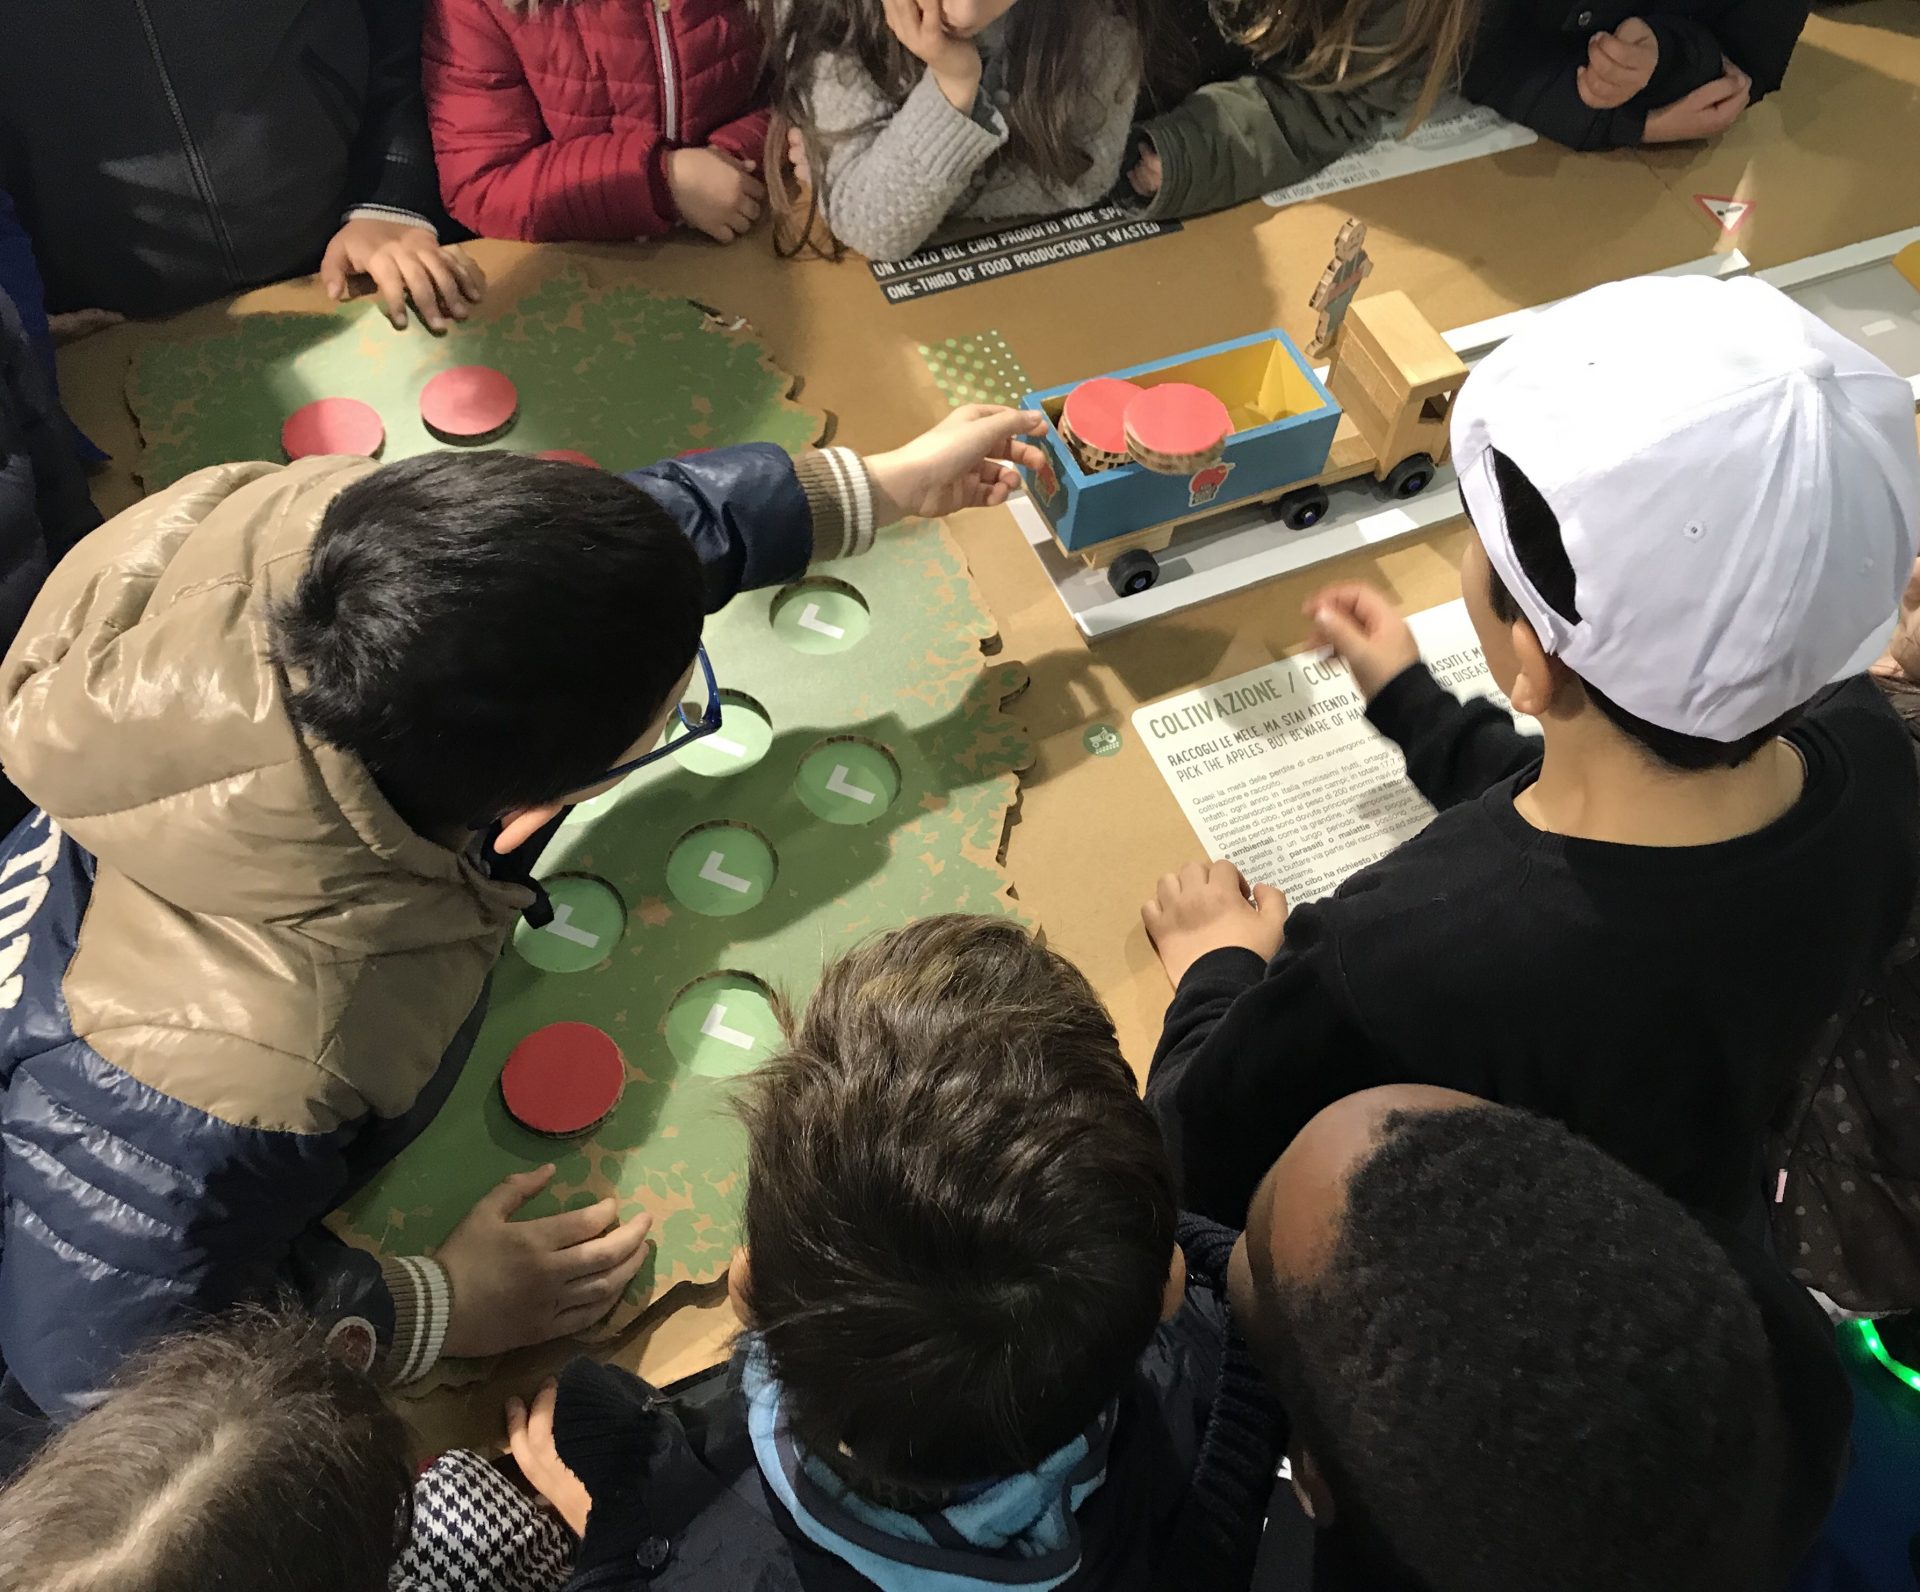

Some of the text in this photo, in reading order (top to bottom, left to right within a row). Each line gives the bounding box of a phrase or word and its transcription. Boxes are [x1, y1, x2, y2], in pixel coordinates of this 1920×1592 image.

[873, 263, 896, 276] UN
[899, 252, 940, 271] TERZO
[942, 245, 966, 260] DEL
[967, 238, 997, 253] CIBO
[999, 222, 1060, 245] PRODOTTO
[1061, 211, 1098, 229] VIENE
[888, 223, 1160, 298] ONE-THIRD OF FOOD PRODUCTION IS WASTED
[1150, 680, 1280, 738] COLTIVAZIONE
[1288, 672, 1294, 693] /
[1168, 741, 1219, 766] RACCOGLI
[1219, 736, 1233, 748] LE
[1263, 719, 1281, 733] MA
[1281, 710, 1306, 726] STAI
[1308, 695, 1349, 717] ATTENTO
[1351, 692, 1360, 702] A
[1462, 651, 1472, 662] E
[1177, 765, 1203, 782] PICK
[1203, 757, 1224, 772] THE
[1267, 733, 1287, 749] BUT
[1289, 719, 1330, 741] BEWARE
[1331, 713, 1344, 726] OF
[1192, 794, 1215, 805] Quasi
[1249, 775, 1267, 785] delle
[1269, 765, 1295, 778] perdite
[1307, 754, 1324, 764] cibo
[1326, 739, 1365, 757] avvengono
[1199, 795, 1242, 814] coltivazione
[1209, 821, 1228, 832] sono
[1229, 803, 1276, 824] abbandonati
[1283, 791, 1311, 804] marcire
[1312, 785, 1323, 794] nei
[1358, 766, 1379, 776] totale
[1213, 824, 1251, 841] tonnellate
[1252, 819, 1260, 827] di
[1281, 807, 1295, 818] pari
[1297, 803, 1304, 811] al
[1305, 797, 1324, 809] peso
[1325, 792, 1332, 800] di
[1332, 787, 1348, 797] 200
[1349, 777, 1374, 791] enormi
[1375, 771, 1391, 781] navi
[1230, 803, 1247, 813] ogni
[1250, 796, 1269, 806] anno
[1281, 784, 1300, 794] Italia
[1302, 769, 1339, 787] moltissimi
[1364, 752, 1389, 764] ortaggi
[1219, 837, 1247, 850] Queste
[1248, 826, 1275, 841] perdite
[1275, 819, 1295, 829] sono
[1295, 809, 1322, 822] dovute
[1322, 789, 1376, 813] principalmente
[1249, 849, 1273, 863] gelata
[1286, 840, 1297, 848] un
[1300, 831, 1322, 842] lungo
[1326, 819, 1355, 834] periodo
[1359, 808, 1381, 820] senza
[1277, 854, 1285, 862] di
[1289, 840, 1324, 859] parassiti
[1338, 824, 1370, 839] malattie
[1278, 828, 1299, 840] come
[1345, 807, 1356, 815] un
[1247, 871, 1276, 885] ontadini
[1283, 857, 1311, 871] buttare
[1324, 845, 1344, 857] parte
[1345, 839, 1357, 848] del
[1358, 828, 1388, 843] raccolto
[1395, 820, 1406, 829] ad
[1305, 876, 1323, 886] cibo
[1323, 871, 1335, 879] ha
[1336, 857, 1371, 874] richiesto
